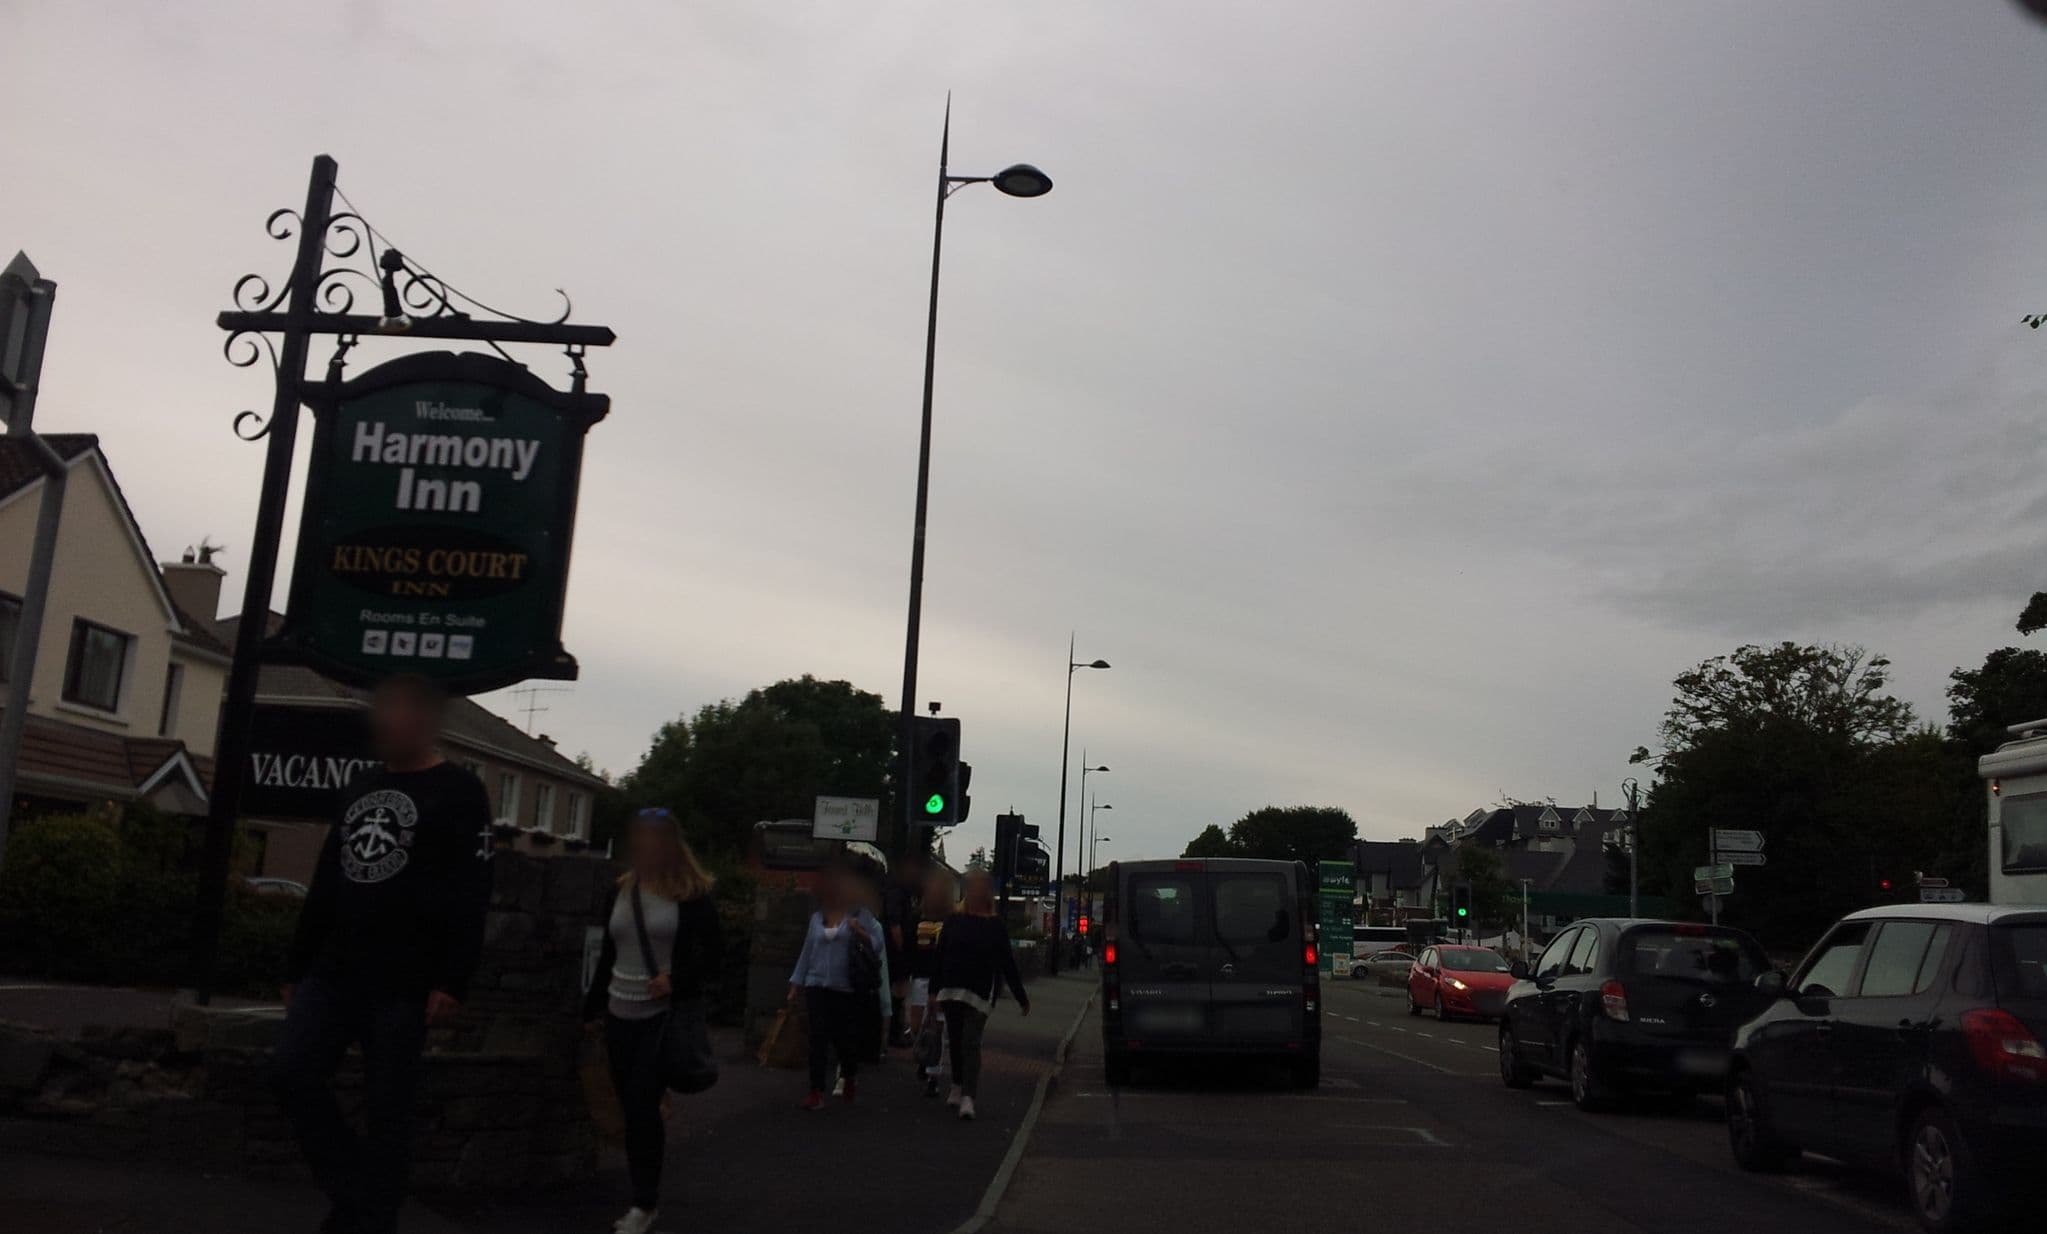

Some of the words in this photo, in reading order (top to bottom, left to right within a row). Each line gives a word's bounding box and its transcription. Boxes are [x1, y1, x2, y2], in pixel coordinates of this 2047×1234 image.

[352, 421, 540, 481] Harmony
[395, 468, 482, 513] Inn
[332, 545, 421, 575] KINGS
[427, 549, 528, 582] COURT
[391, 580, 450, 598] INN
[359, 608, 415, 625] Rooms
[419, 611, 441, 625] En
[444, 612, 487, 628] Suite
[250, 752, 384, 789] VACANC
